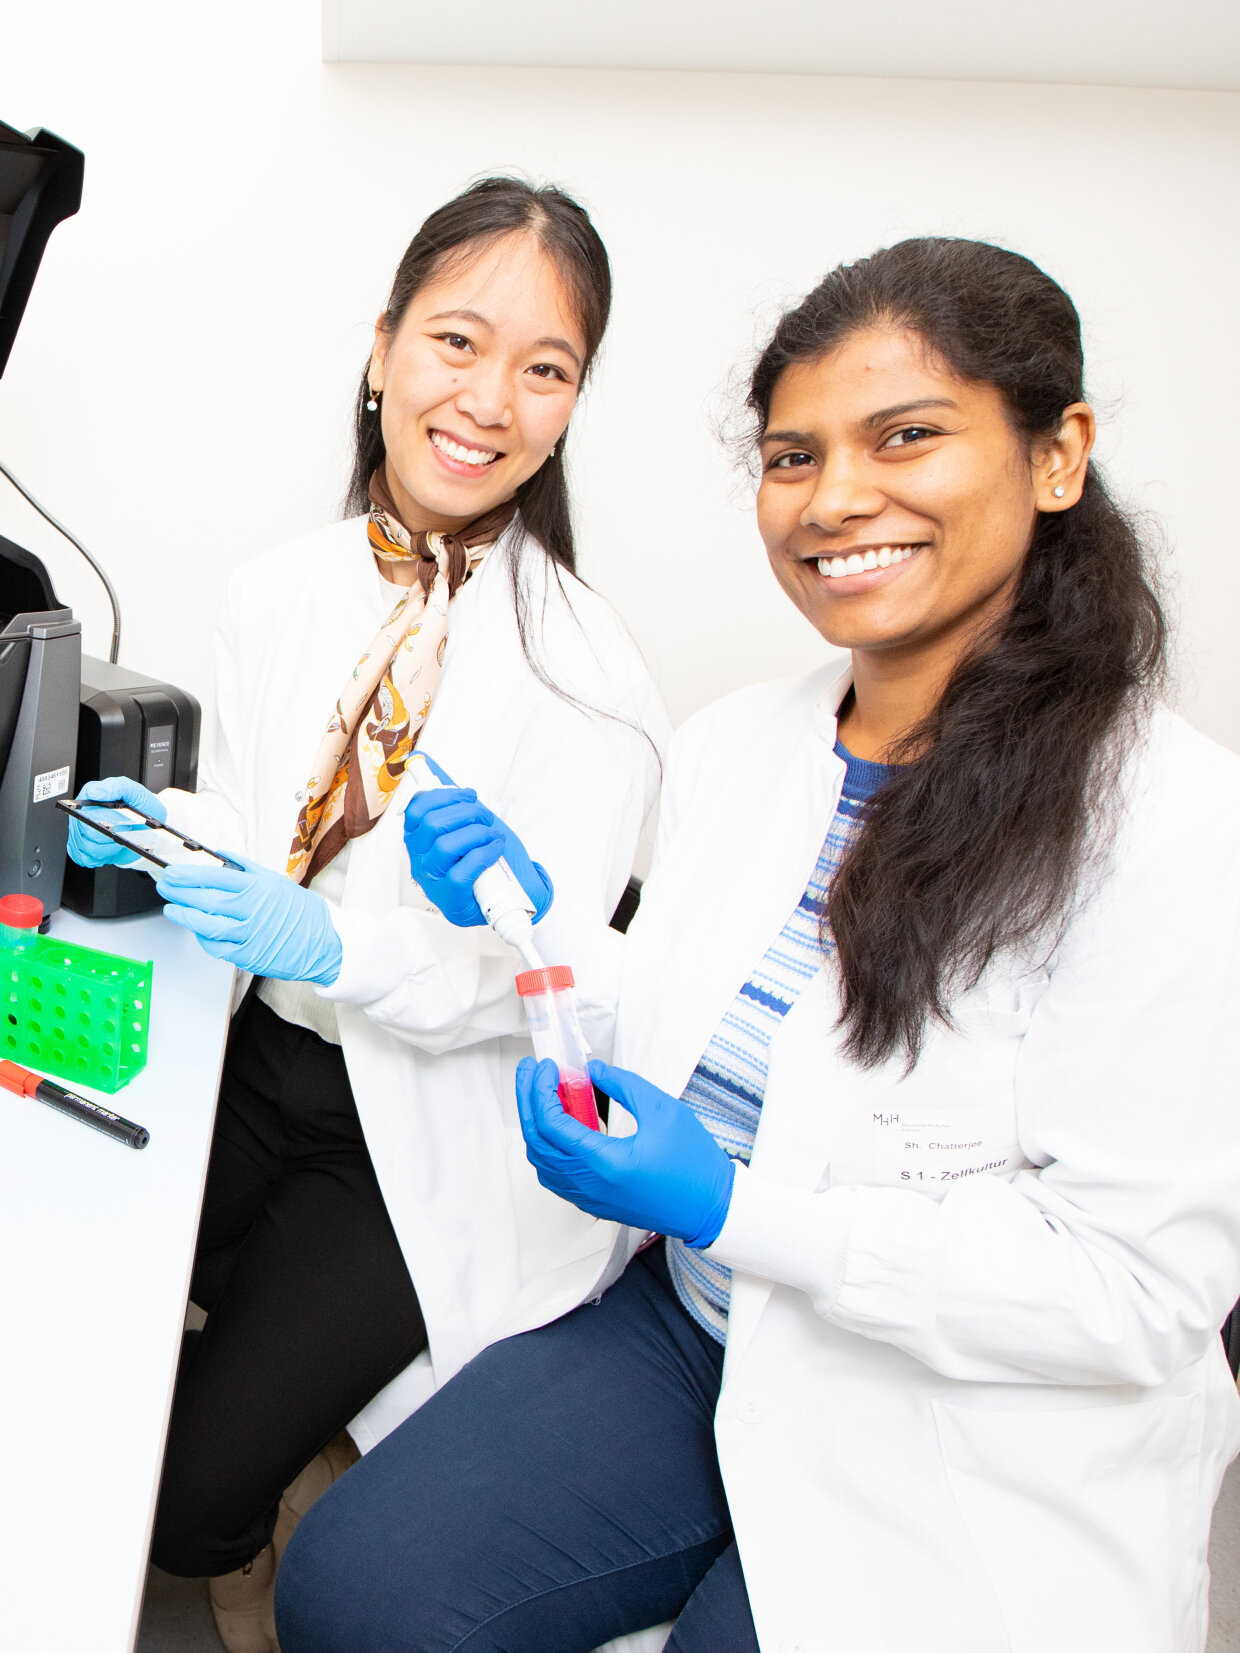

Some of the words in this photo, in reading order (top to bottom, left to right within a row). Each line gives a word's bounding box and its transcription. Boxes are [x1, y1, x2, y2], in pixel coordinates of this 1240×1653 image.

[904, 1141, 921, 1149] Sh.
[928, 1140, 983, 1150] Chatterjee
[940, 1158, 1009, 1181] Zellkultur
